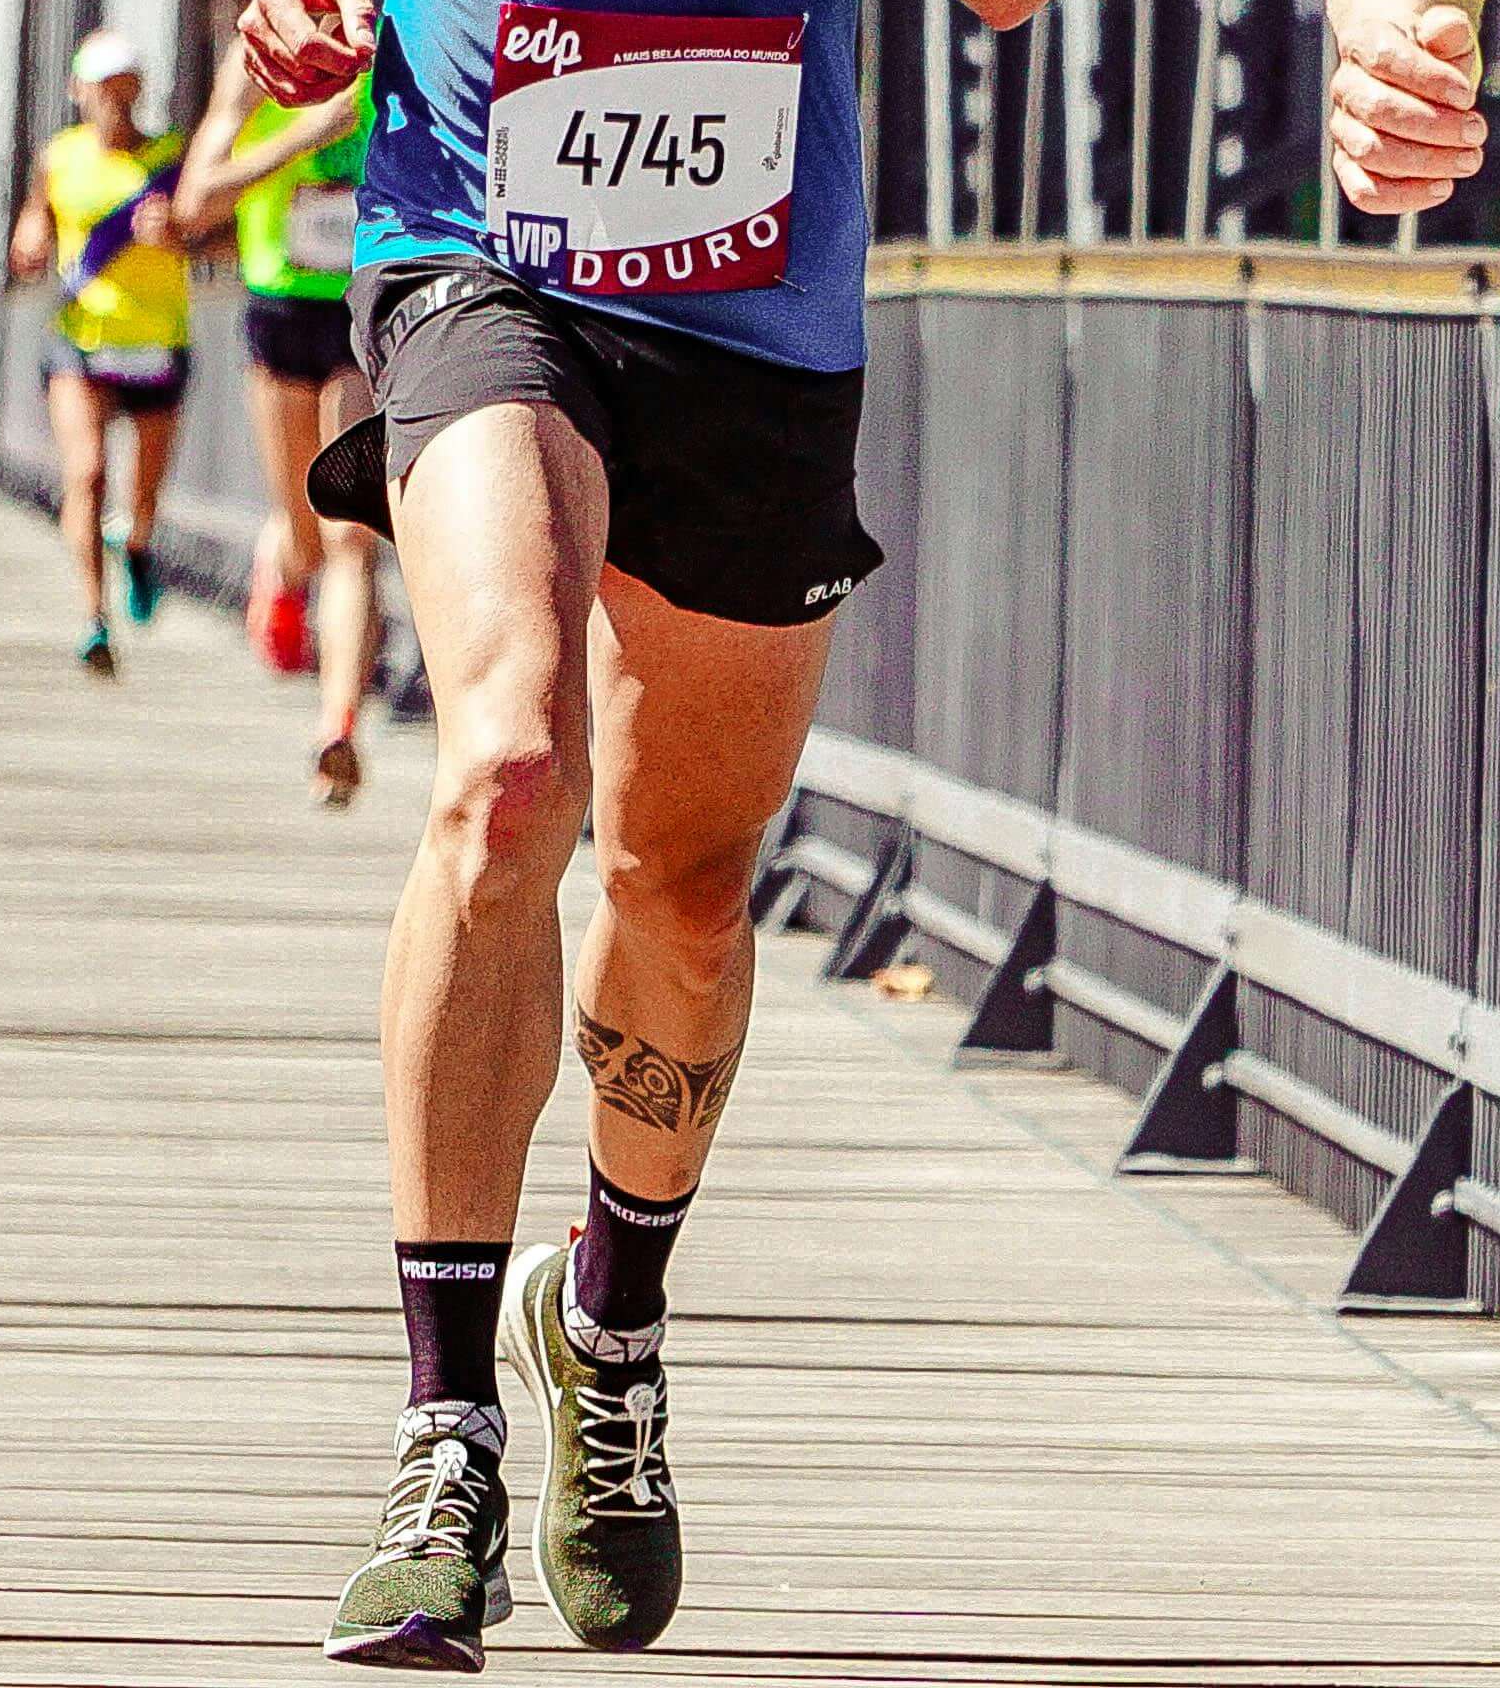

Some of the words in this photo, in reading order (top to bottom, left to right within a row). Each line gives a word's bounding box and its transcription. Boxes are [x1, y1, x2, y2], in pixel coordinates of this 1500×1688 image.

[503, 18, 582, 76] edp
[613, 53, 621, 65] A
[622, 50, 651, 63] MAIS
[651, 48, 681, 60] BELA
[683, 47, 731, 60] CORRIDA
[733, 49, 750, 60] DO
[751, 49, 790, 62] MUNDO
[556, 109, 728, 188] 4745
[509, 219, 562, 269] VIP
[572, 213, 780, 287] DOURO
